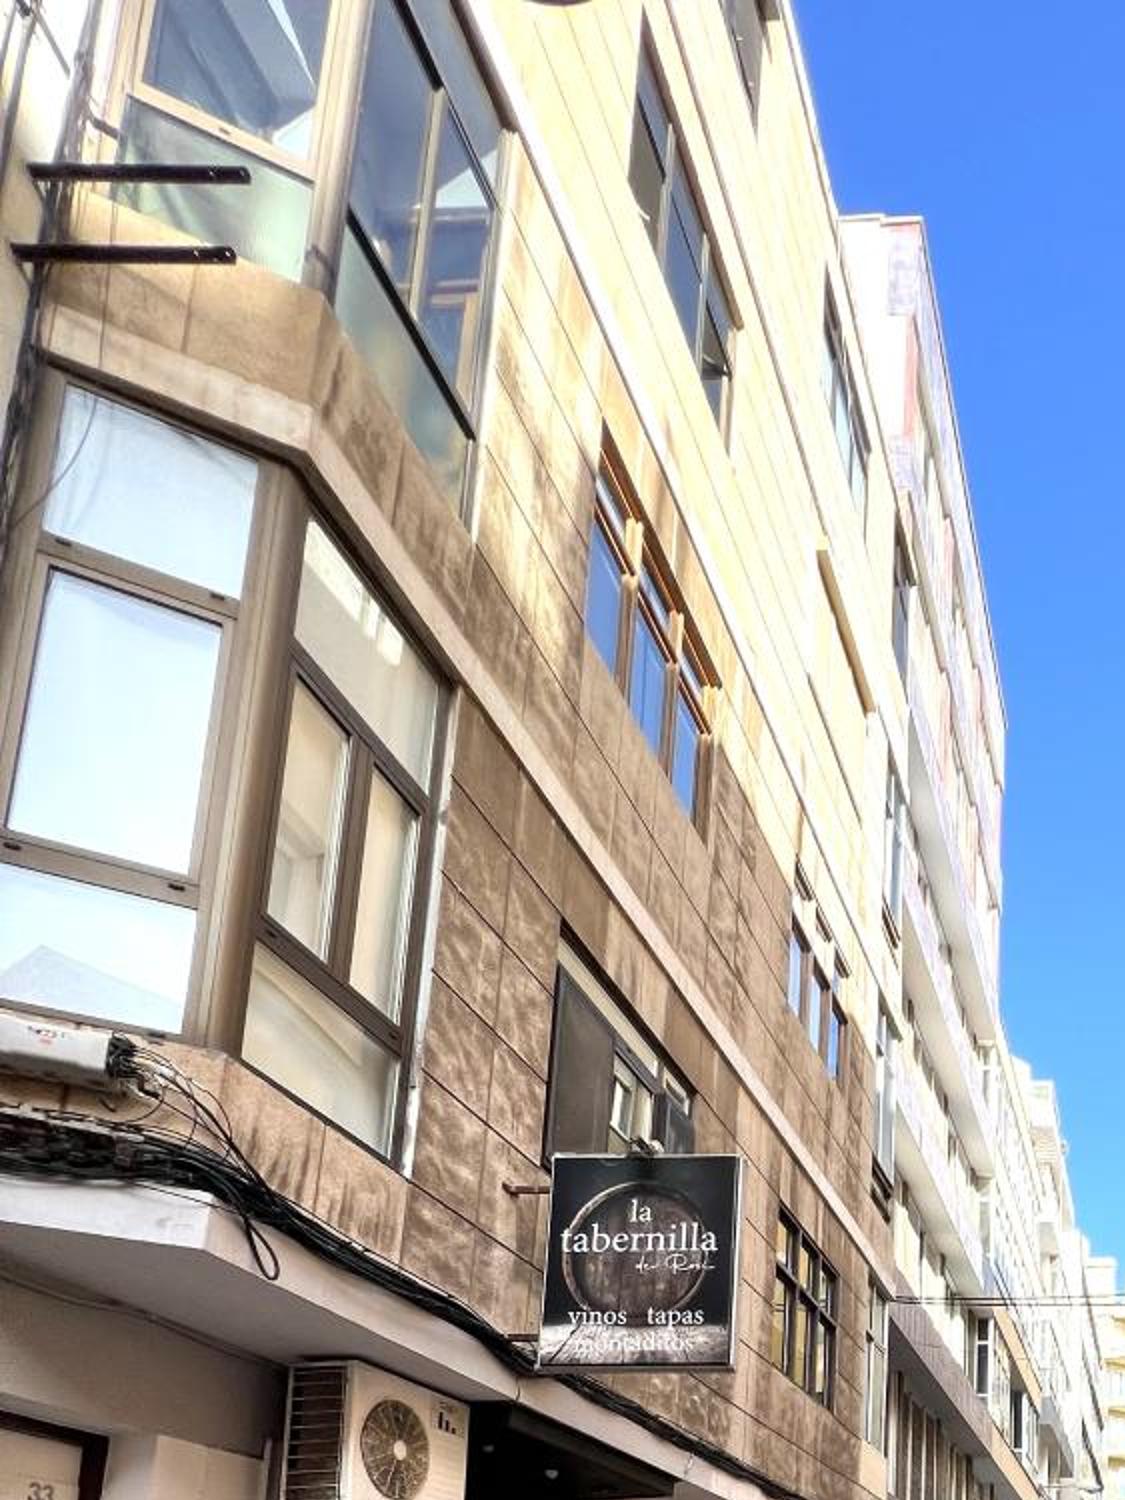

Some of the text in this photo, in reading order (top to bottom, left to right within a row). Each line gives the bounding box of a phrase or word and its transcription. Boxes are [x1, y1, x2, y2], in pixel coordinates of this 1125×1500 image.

[630, 1199, 652, 1224] la
[561, 1222, 719, 1254] tabernilla
[567, 1307, 705, 1332] vinos tapas
